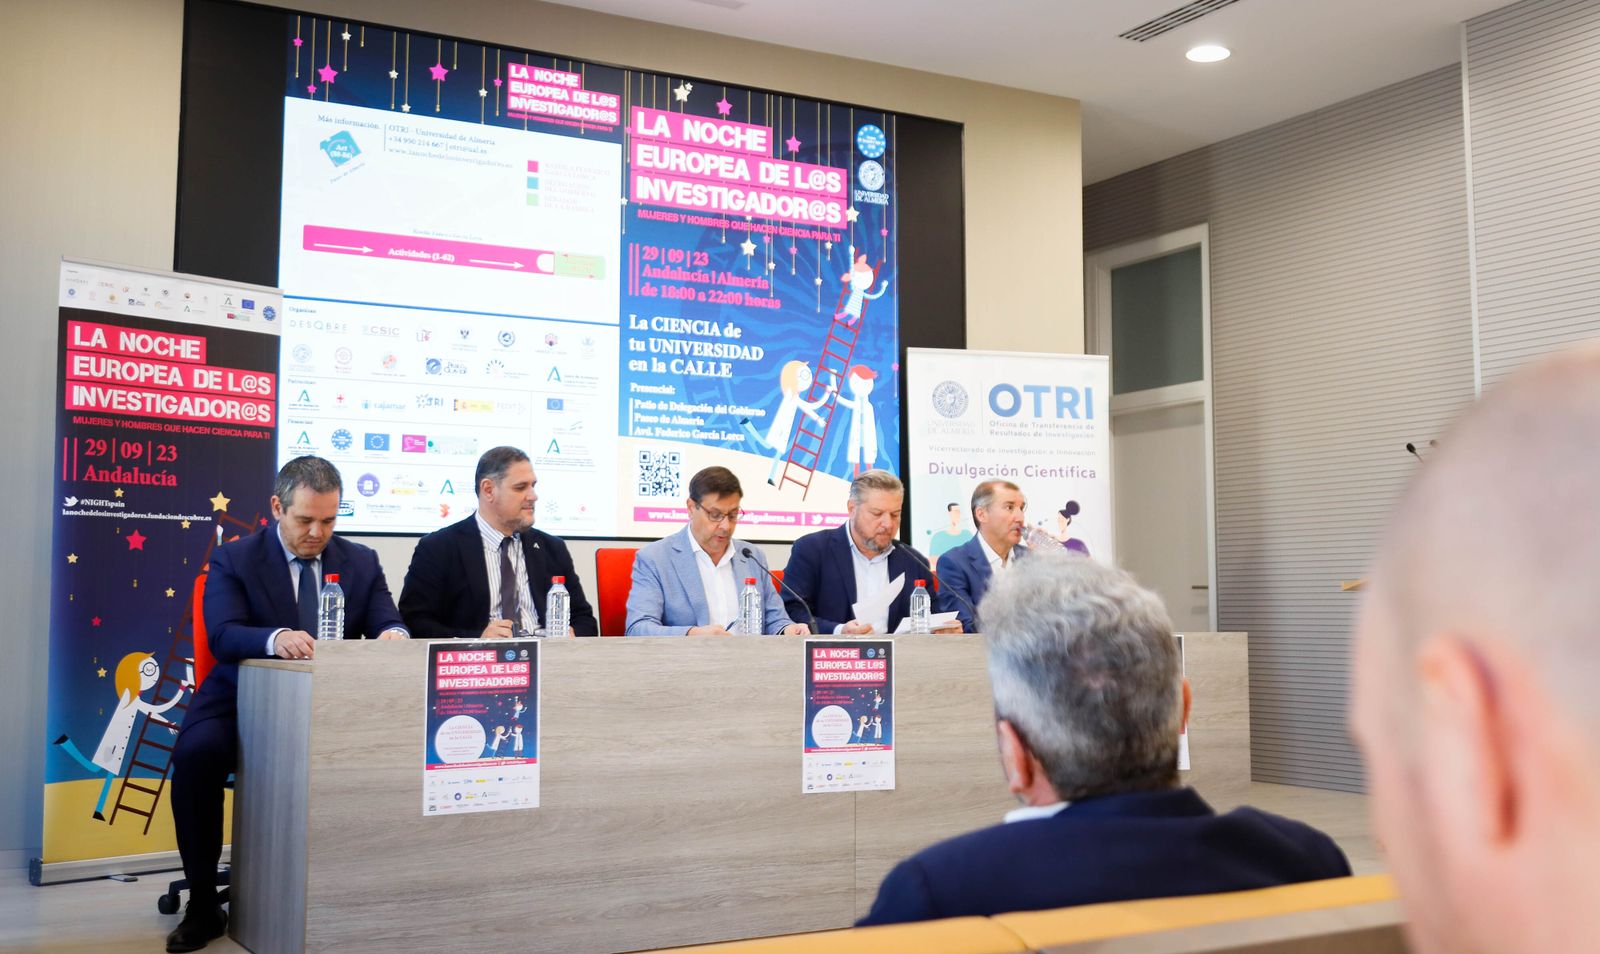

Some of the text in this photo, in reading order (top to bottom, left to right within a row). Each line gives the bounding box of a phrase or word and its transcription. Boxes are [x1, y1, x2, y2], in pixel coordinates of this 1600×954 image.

[510, 65, 579, 87] LA NOCHE
[510, 80, 617, 108] EUROPEA DE L@S
[510, 96, 617, 123] INVESTIGADOR@S
[637, 111, 672, 138] LA
[683, 118, 767, 153] NOCHE
[637, 143, 842, 194] EUROPEA DE L@S
[636, 175, 842, 224] INVESTIGADOR@S
[637, 209, 680, 223] MUJERES
[680, 214, 686, 223] Y
[687, 216, 730, 229] HOMBRES
[731, 221, 749, 231] QUE
[750, 223, 778, 235] HACEN
[779, 227, 810, 238] CIENCIA
[811, 231, 832, 241] PARA
[642, 246, 709, 266] 29 09 23
[642, 264, 769, 289] Andalucía Almería
[641, 282, 781, 309] de 18:00 a 22:00 horas
[629, 314, 742, 339] La CIENCIA de
[74, 325, 200, 360] LA NOCHE
[629, 337, 764, 360] tu UNIVERSIDAD
[73, 355, 271, 395] EUROPEA DE L@S
[628, 357, 733, 378] en la CALLE
[72, 385, 271, 422] INVESTIGADOR@S
[634, 399, 766, 417] Patio de Delegación del Gobierno
[988, 383, 1095, 420] OTRI
[73, 416, 113, 427] MUJERES
[114, 418, 121, 428] Y
[122, 420, 162, 432] HOMBRES
[164, 423, 181, 433] QUE
[182, 425, 210, 435] HACEN
[211, 427, 242, 438] CIENCIA
[243, 430, 263, 439] PARA
[660, 414, 670, 423] de
[671, 415, 705, 426] Almería
[989, 420, 1018, 428] Oficina
[1031, 421, 1084, 430] Transferencia
[692, 430, 720, 440] García
[989, 429, 1031, 438] Resultados
[84, 438, 178, 462] 29 09 23
[986, 446, 996, 454] de
[83, 464, 178, 487] Andalucía
[928, 461, 1096, 479] Divulgación Científica
[80, 498, 125, 508] #NIGHTspain
[439, 652, 495, 663] LA NOCHE
[814, 649, 858, 658] LA NOCHE
[439, 663, 527, 675] EUROPEA DE L@S
[814, 661, 852, 669] EUROPEA
[855, 661, 866, 669] DE
[439, 676, 527, 688] INVESTIGADOR@S
[814, 672, 884, 681] INVESTIGADOR@S
